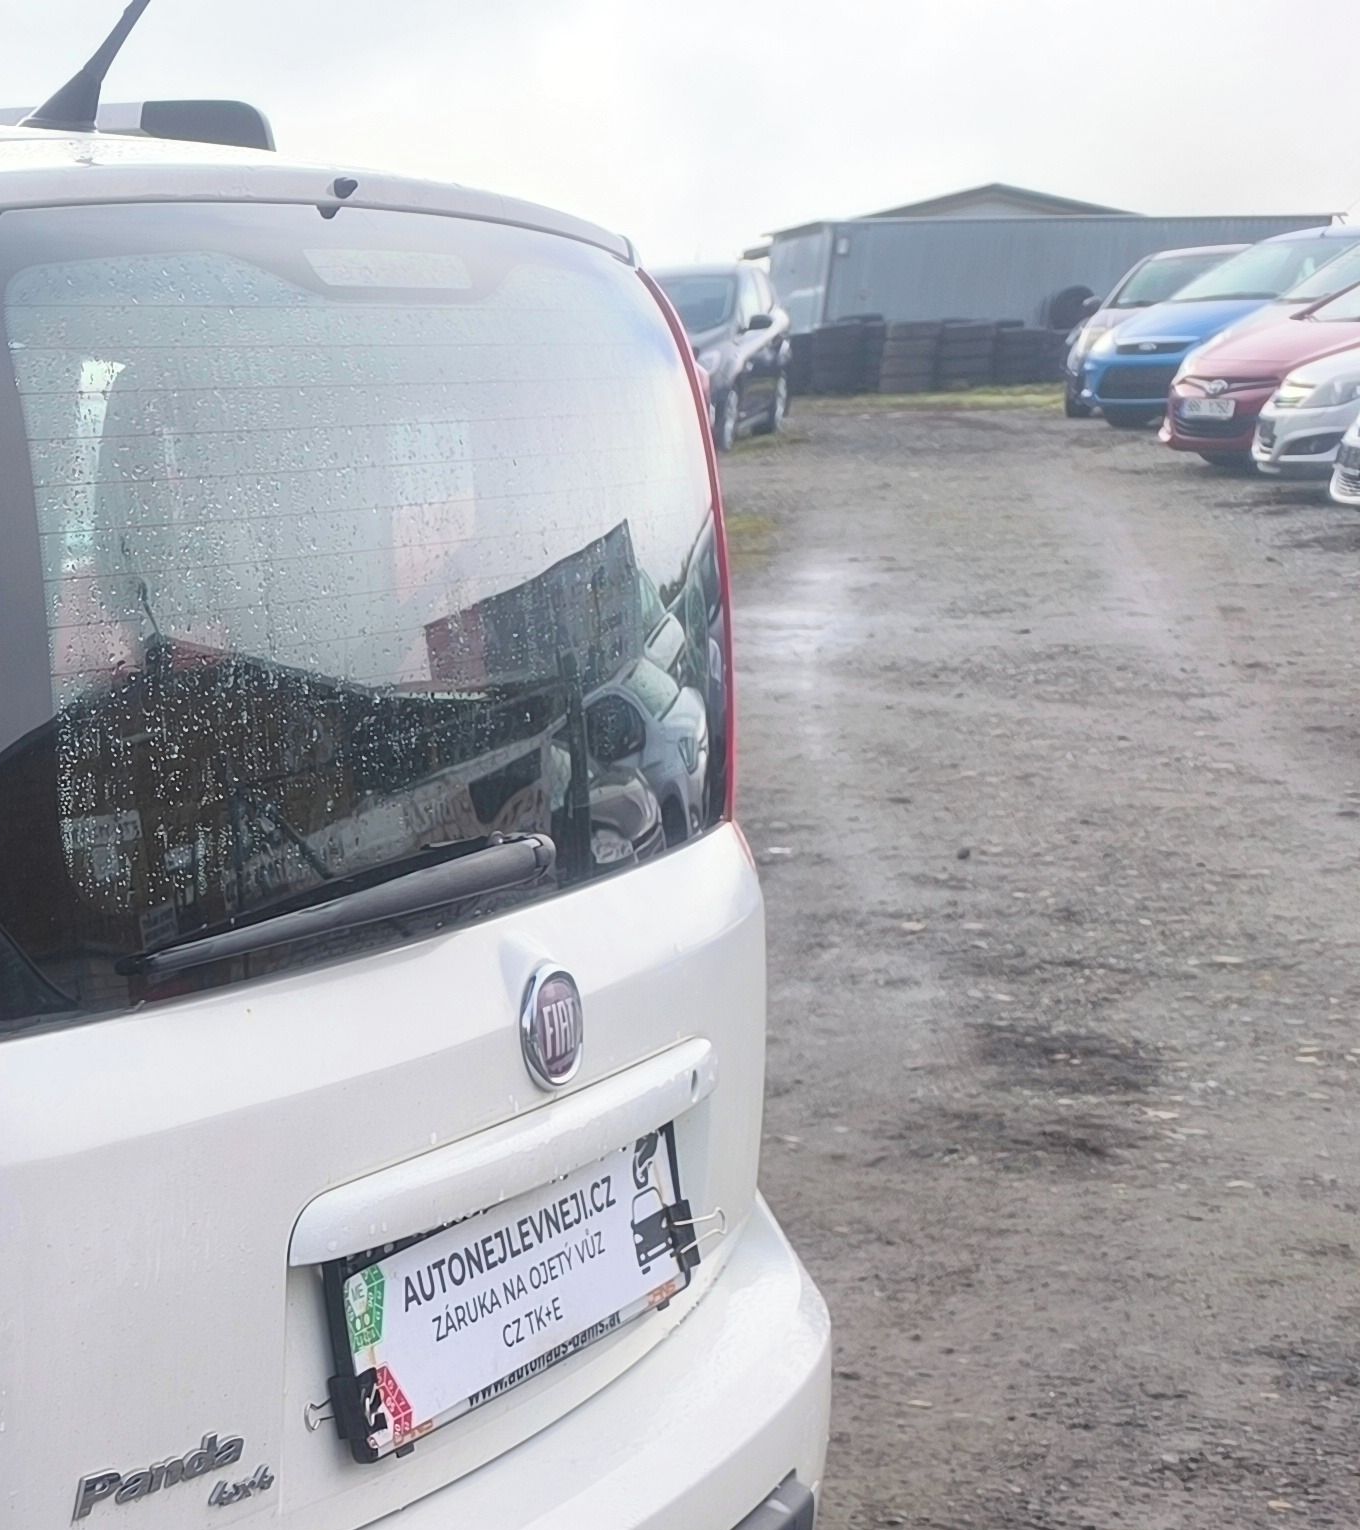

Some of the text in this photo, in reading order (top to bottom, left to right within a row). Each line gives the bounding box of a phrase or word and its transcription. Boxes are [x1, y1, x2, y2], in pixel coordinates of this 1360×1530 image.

[542, 997, 576, 1060] FIAT
[404, 1175, 617, 1312] AUTONEJLEVNEJI.CZ
[432, 1228, 606, 1342] ZÁRUKA NA OJETÝ VŮZ
[502, 1297, 564, 1348] CZ TK+E
[72, 1431, 245, 1521] Panda
[207, 1464, 275, 1507] 4x4
